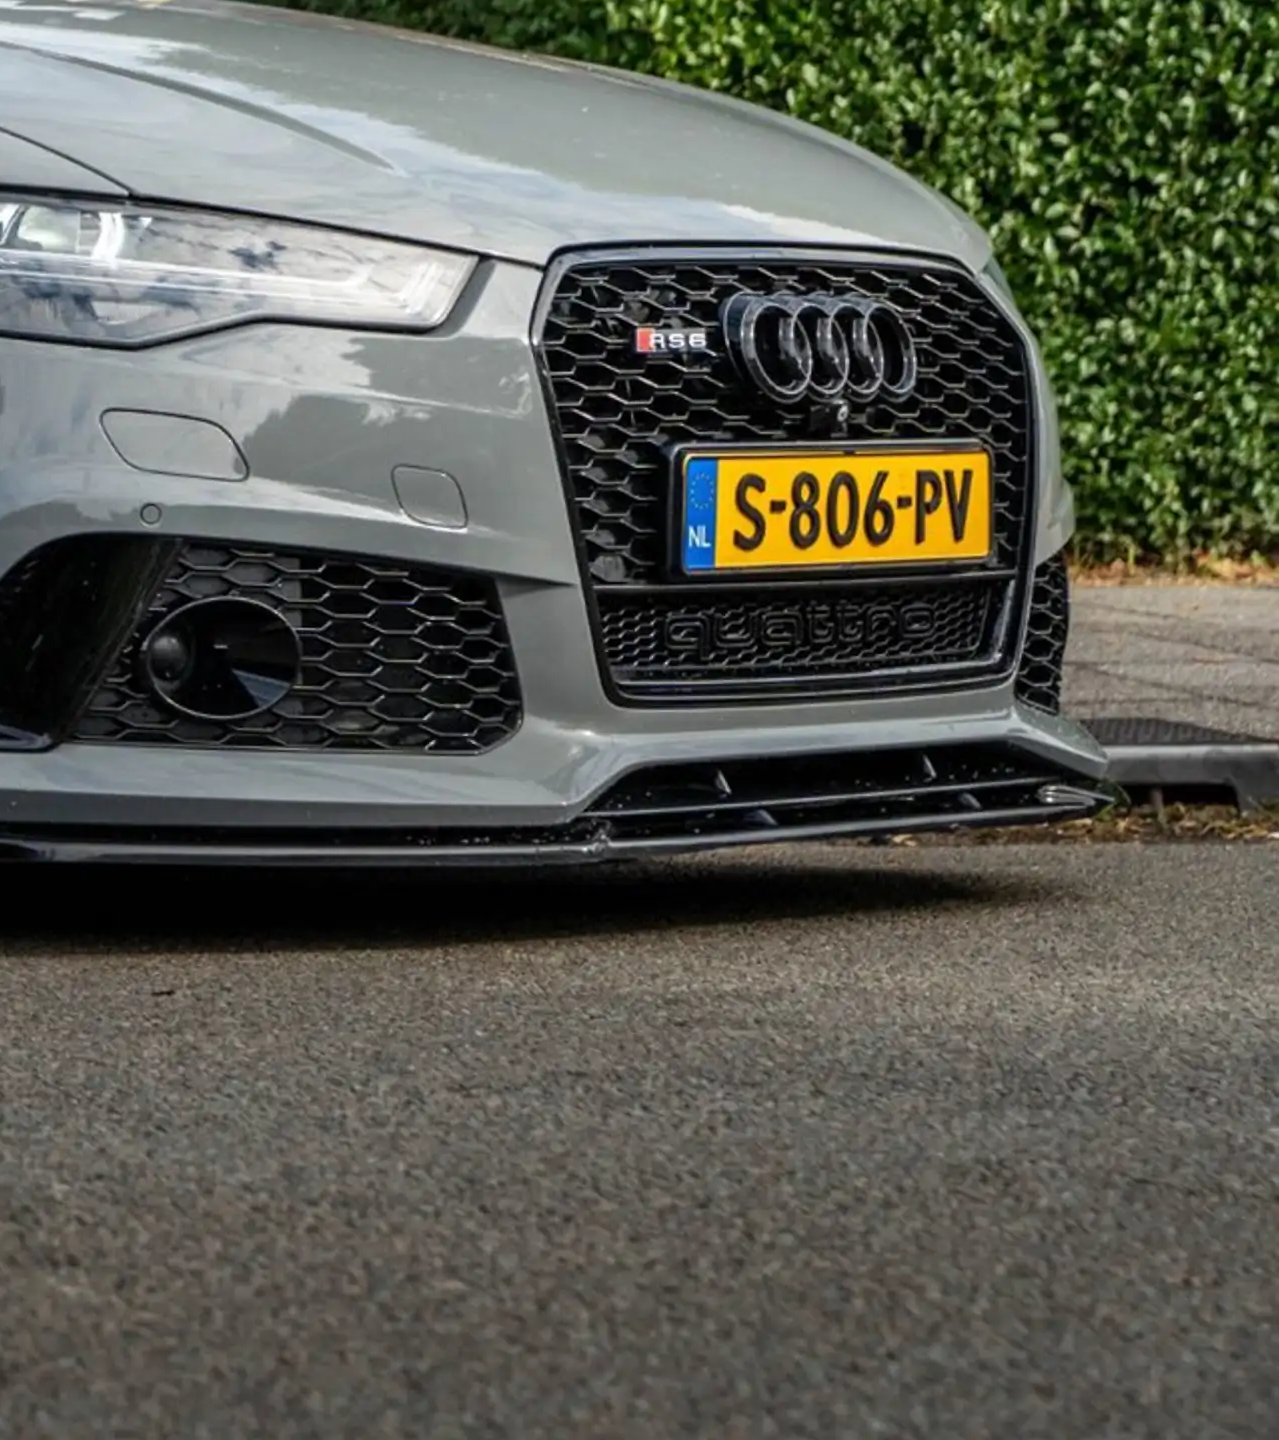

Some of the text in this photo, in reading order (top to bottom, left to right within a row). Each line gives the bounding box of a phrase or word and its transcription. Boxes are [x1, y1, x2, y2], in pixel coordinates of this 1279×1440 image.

[647, 331, 708, 350] RS6
[732, 469, 974, 552] S-806-PV
[688, 525, 712, 550] NL
[664, 600, 939, 660] quattro
